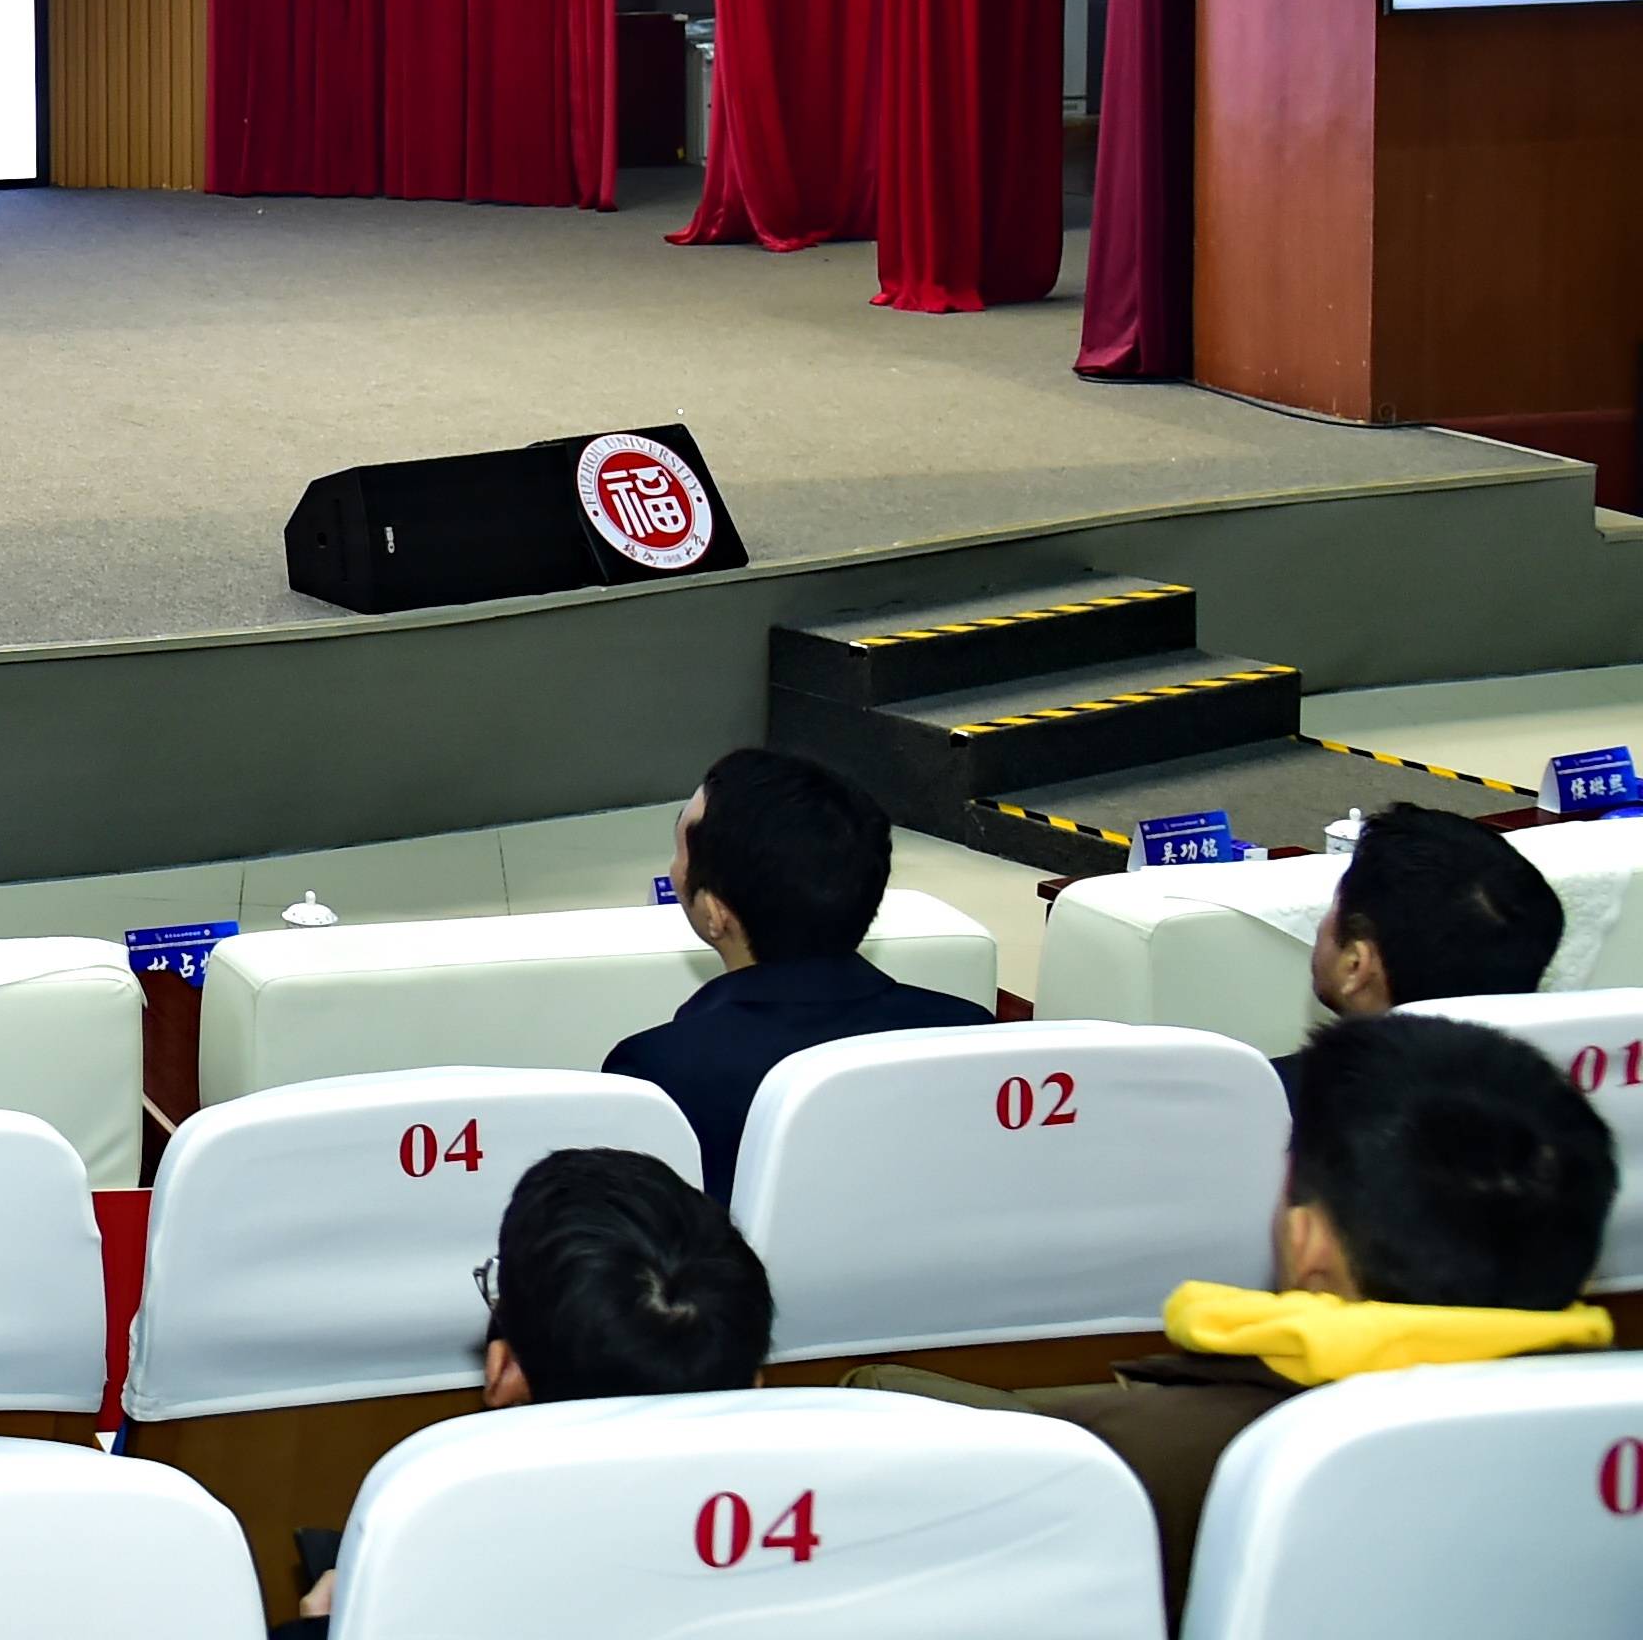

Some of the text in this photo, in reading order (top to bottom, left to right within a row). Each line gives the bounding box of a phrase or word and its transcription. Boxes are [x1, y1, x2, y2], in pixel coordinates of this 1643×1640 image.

[604, 436, 701, 490] UNIVERSITY
[995, 1071, 1078, 1132] 02
[398, 1117, 484, 1181] 04
[694, 1489, 822, 1569] 04
